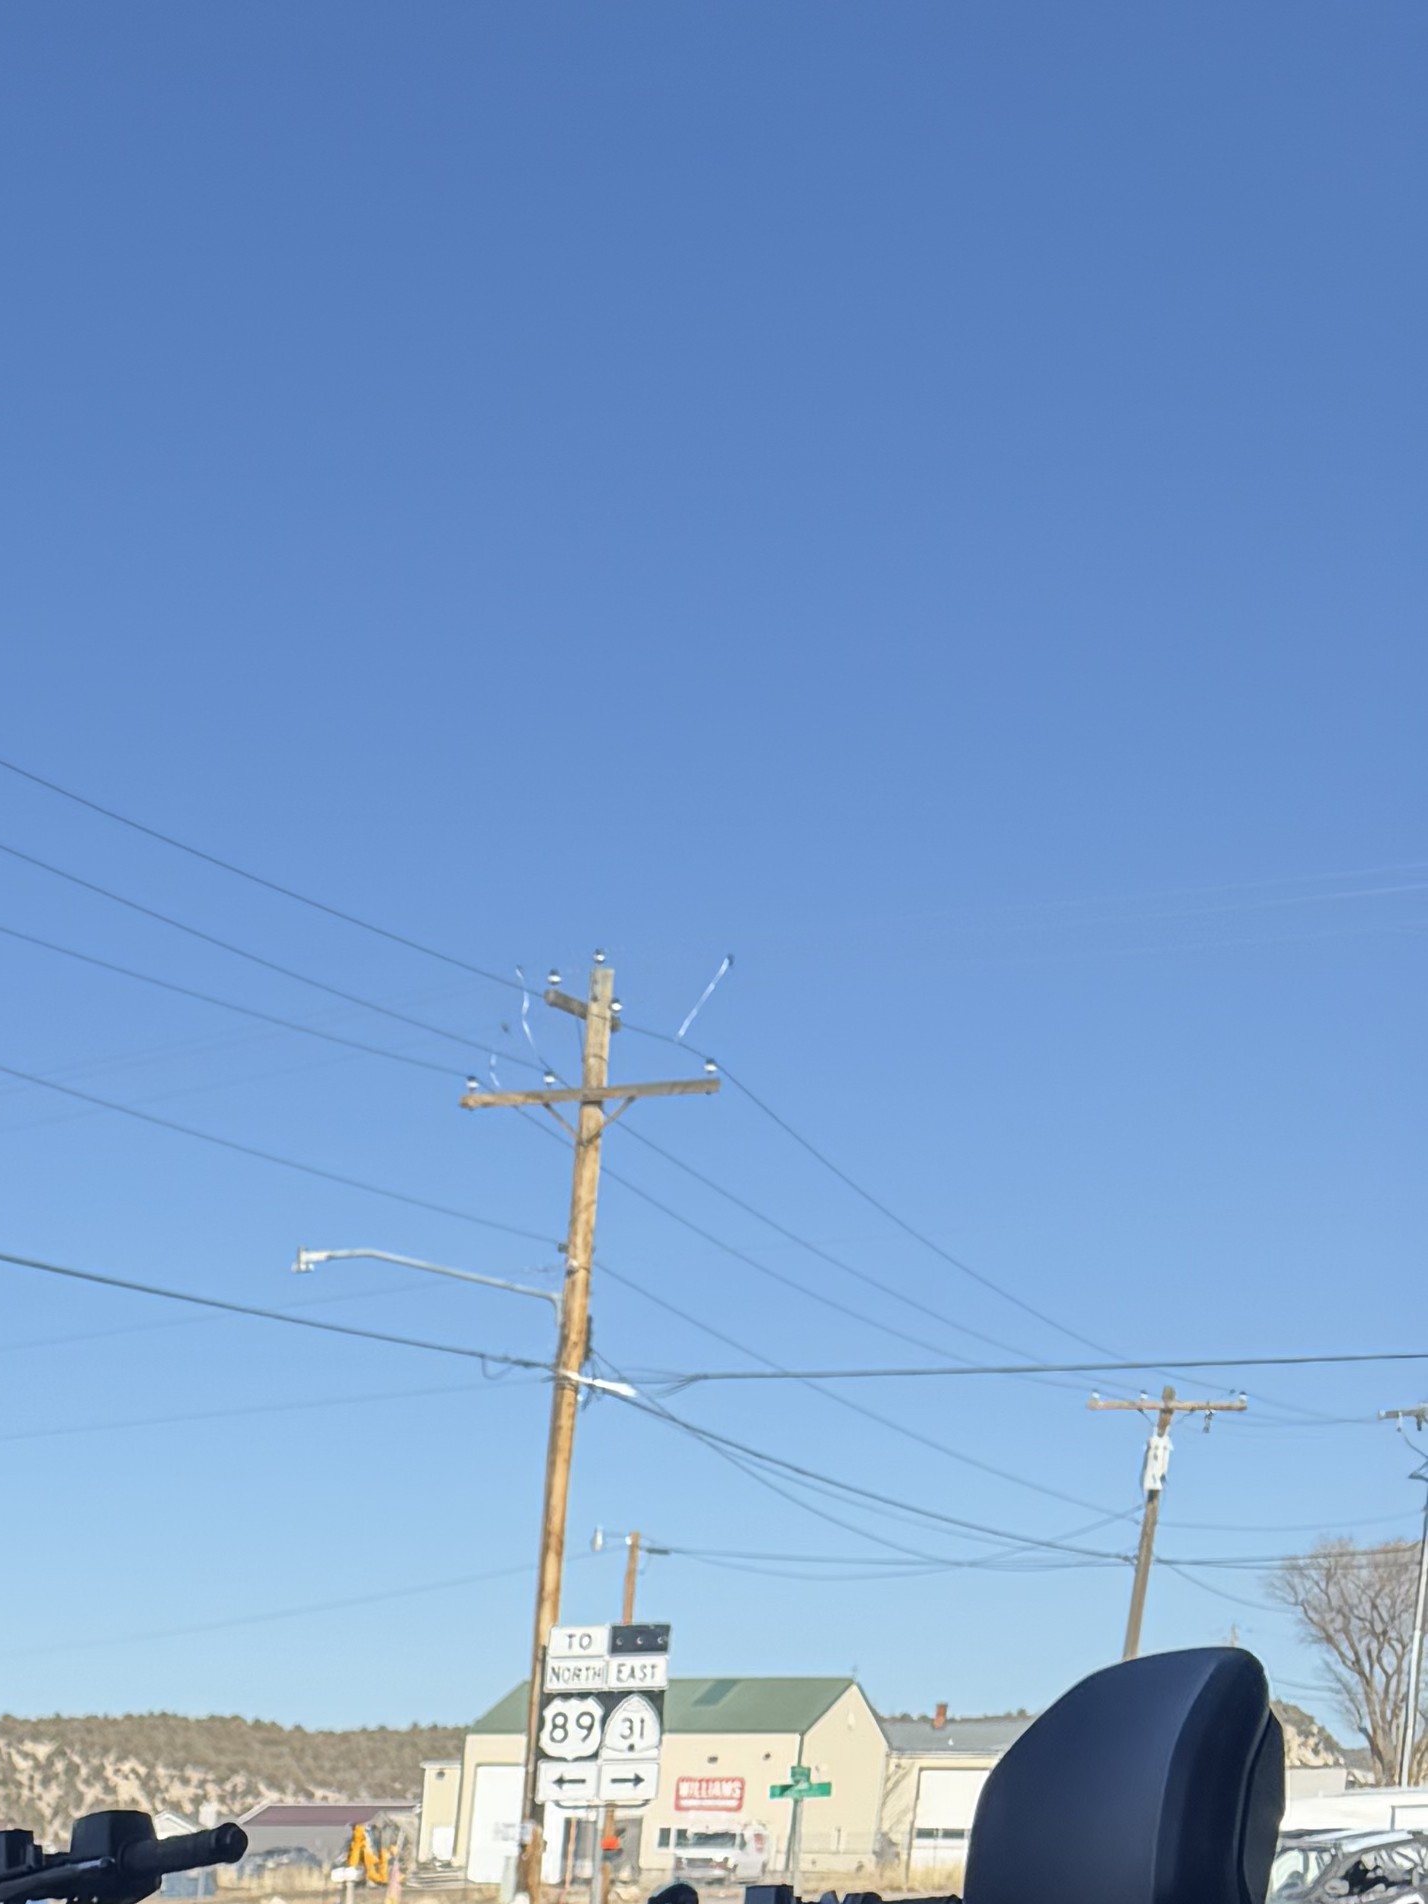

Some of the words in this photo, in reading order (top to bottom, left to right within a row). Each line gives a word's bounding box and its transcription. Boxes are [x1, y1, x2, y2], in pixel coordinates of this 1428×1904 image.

[566, 1633, 593, 1650] TO
[549, 1665, 602, 1684] NORTH
[616, 1663, 658, 1682] EAST
[549, 1711, 596, 1743] 89
[620, 1717, 646, 1740] 31
[679, 1779, 742, 1798] WILLIAMS
